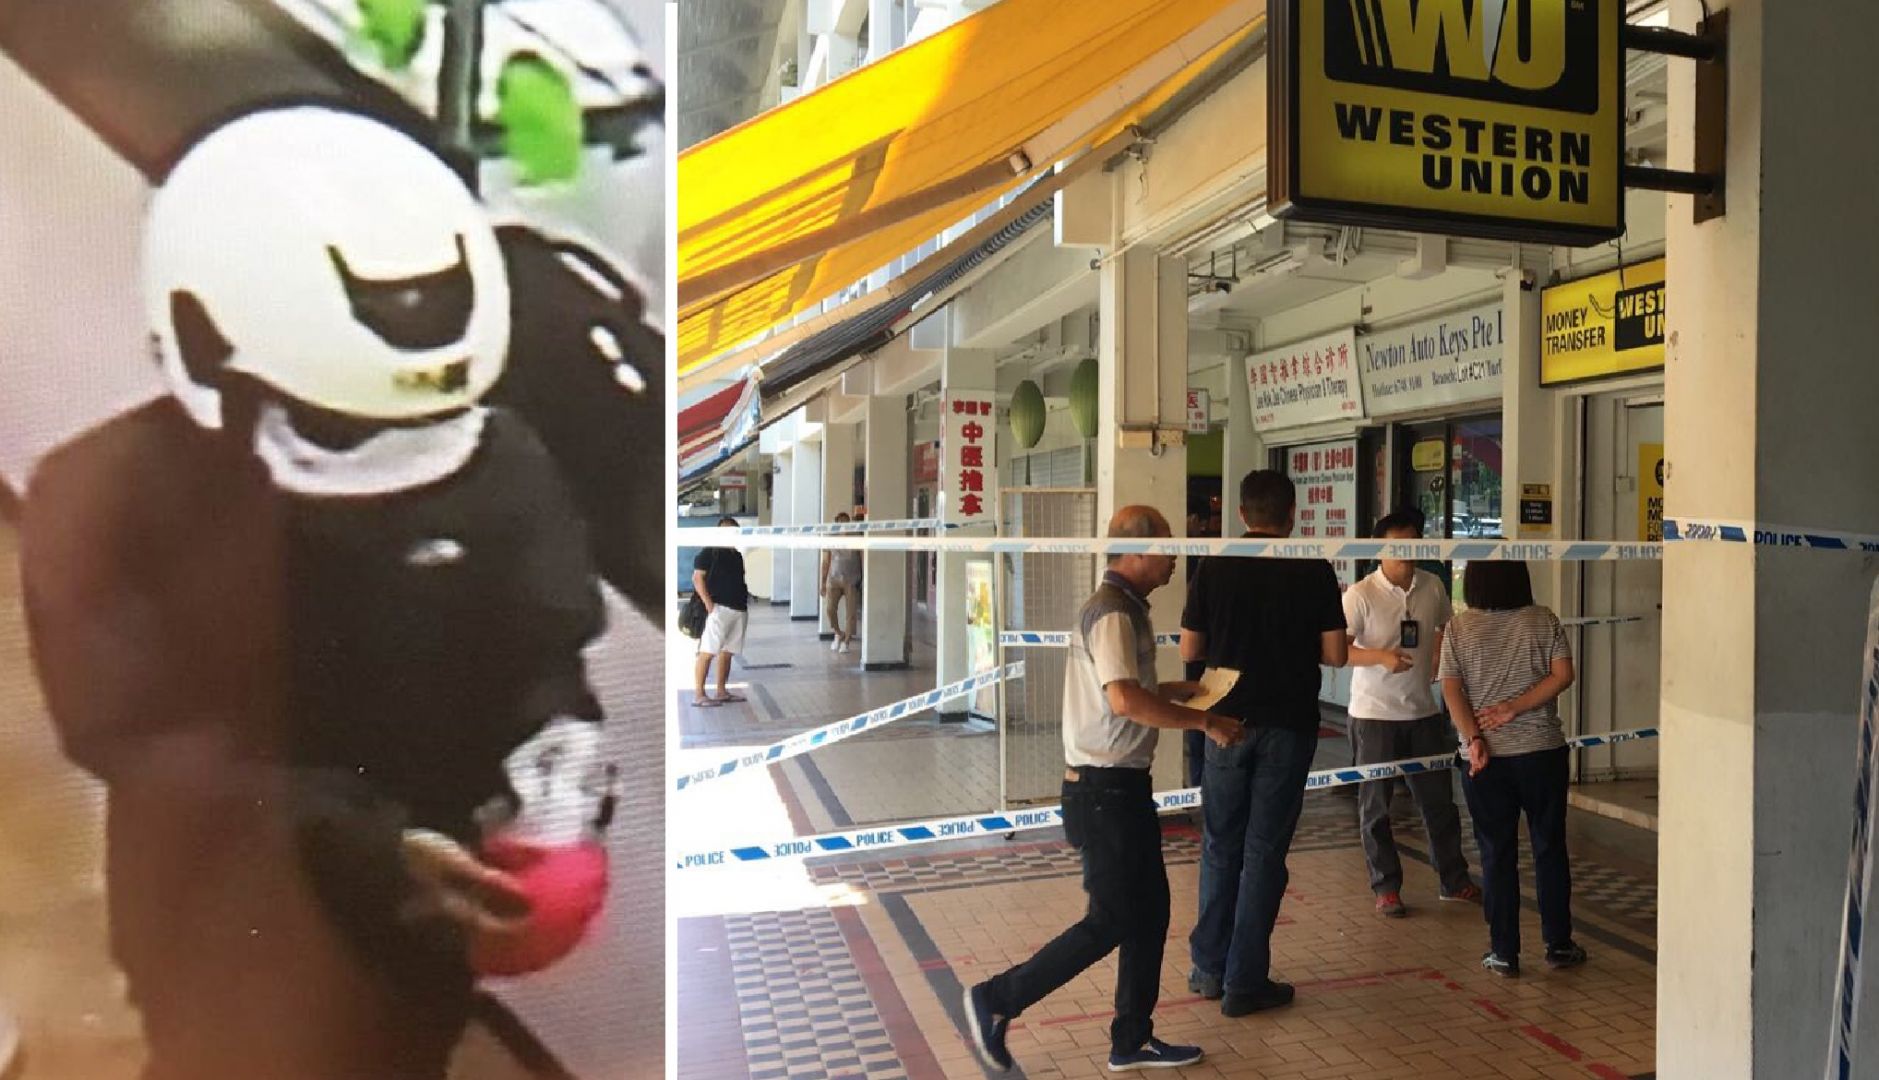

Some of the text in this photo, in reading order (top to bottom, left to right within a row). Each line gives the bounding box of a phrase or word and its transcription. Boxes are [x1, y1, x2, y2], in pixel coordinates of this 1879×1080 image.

[1334, 102, 1590, 167] WESTERN
[1422, 154, 1589, 204] UNION
[1619, 288, 1665, 320] WEST
[1546, 307, 1588, 334] MONEY
[1644, 312, 1665, 339] UN
[1366, 342, 1406, 373] Newton
[1409, 332, 1435, 363] Auto
[1439, 323, 1469, 362] Keys
[1472, 315, 1493, 349] Pte
[1546, 326, 1606, 355] TRANSFER
[1307, 775, 1332, 787] OLICE
[1163, 791, 1196, 807] POLICE
[938, 820, 974, 836] POLICE
[1015, 811, 1050, 826] POLICE
[774, 840, 812, 858] POLICE
[856, 830, 894, 847] POLICE
[684, 850, 725, 868] POLICE
